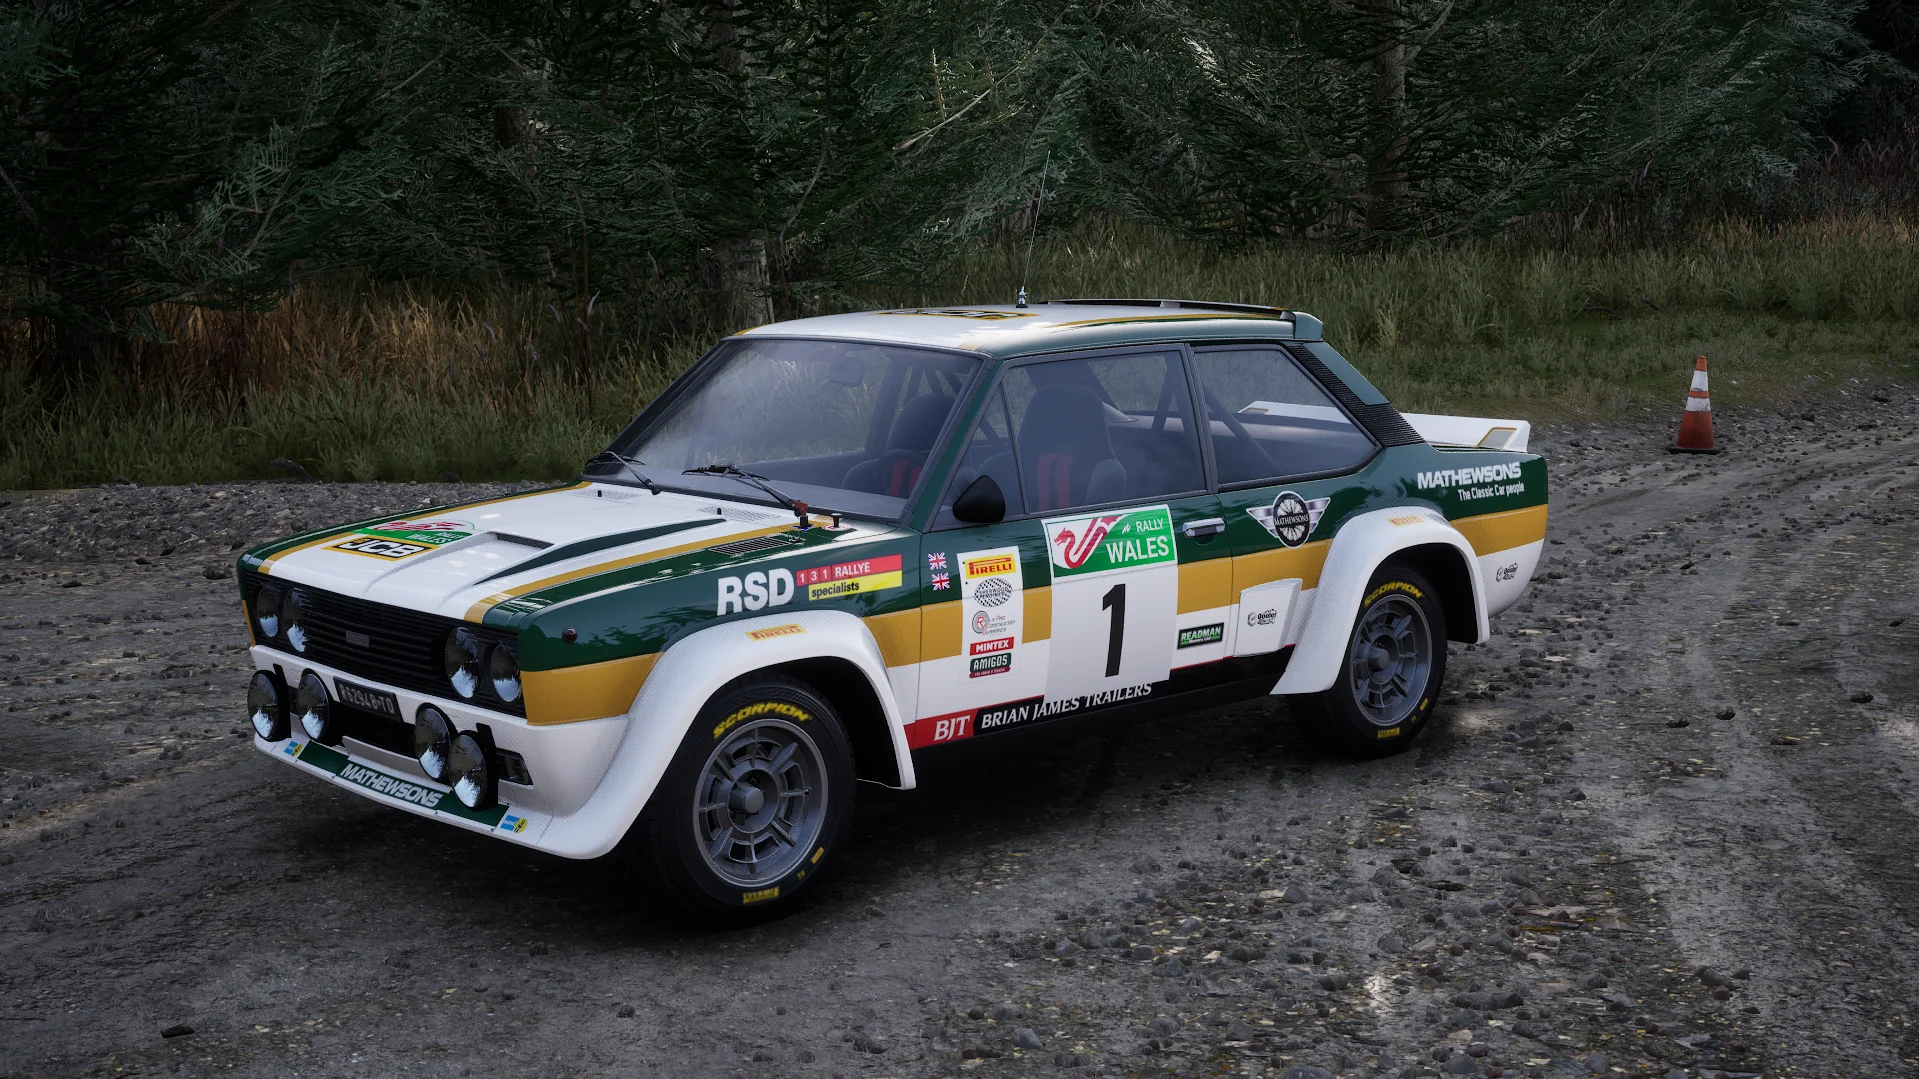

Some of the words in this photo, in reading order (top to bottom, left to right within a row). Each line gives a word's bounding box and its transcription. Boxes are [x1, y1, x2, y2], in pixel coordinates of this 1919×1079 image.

[1417, 462, 1522, 490] MATHEWSONS
[1458, 488, 1471, 502] The
[1471, 485, 1494, 501] Classic
[1494, 484, 1505, 497] Car
[1505, 481, 1525, 499] people
[1136, 518, 1164, 533] RALLY
[1274, 514, 1310, 527] MATHEWSONS
[338, 538, 425, 558] JCB
[1106, 535, 1170, 564] WALES
[834, 561, 871, 578] RALLYE
[969, 557, 1012, 576] PIRELLI
[716, 567, 795, 617] RSD
[811, 581, 860, 599] specialists
[1363, 580, 1425, 608] SCORPION
[750, 624, 803, 641] PIRELLI
[1102, 583, 1126, 678] 1
[1180, 626, 1222, 641] READMAN
[975, 639, 1010, 653] MINTEX
[973, 655, 1009, 671] AMIGOS
[712, 701, 812, 740] SCORPION
[933, 714, 971, 742] BJT
[980, 705, 1029, 730] BRIAN
[1031, 697, 1081, 721] JAMES
[1083, 682, 1153, 709] TRAILERS
[340, 763, 443, 808] MATHEWSONS
